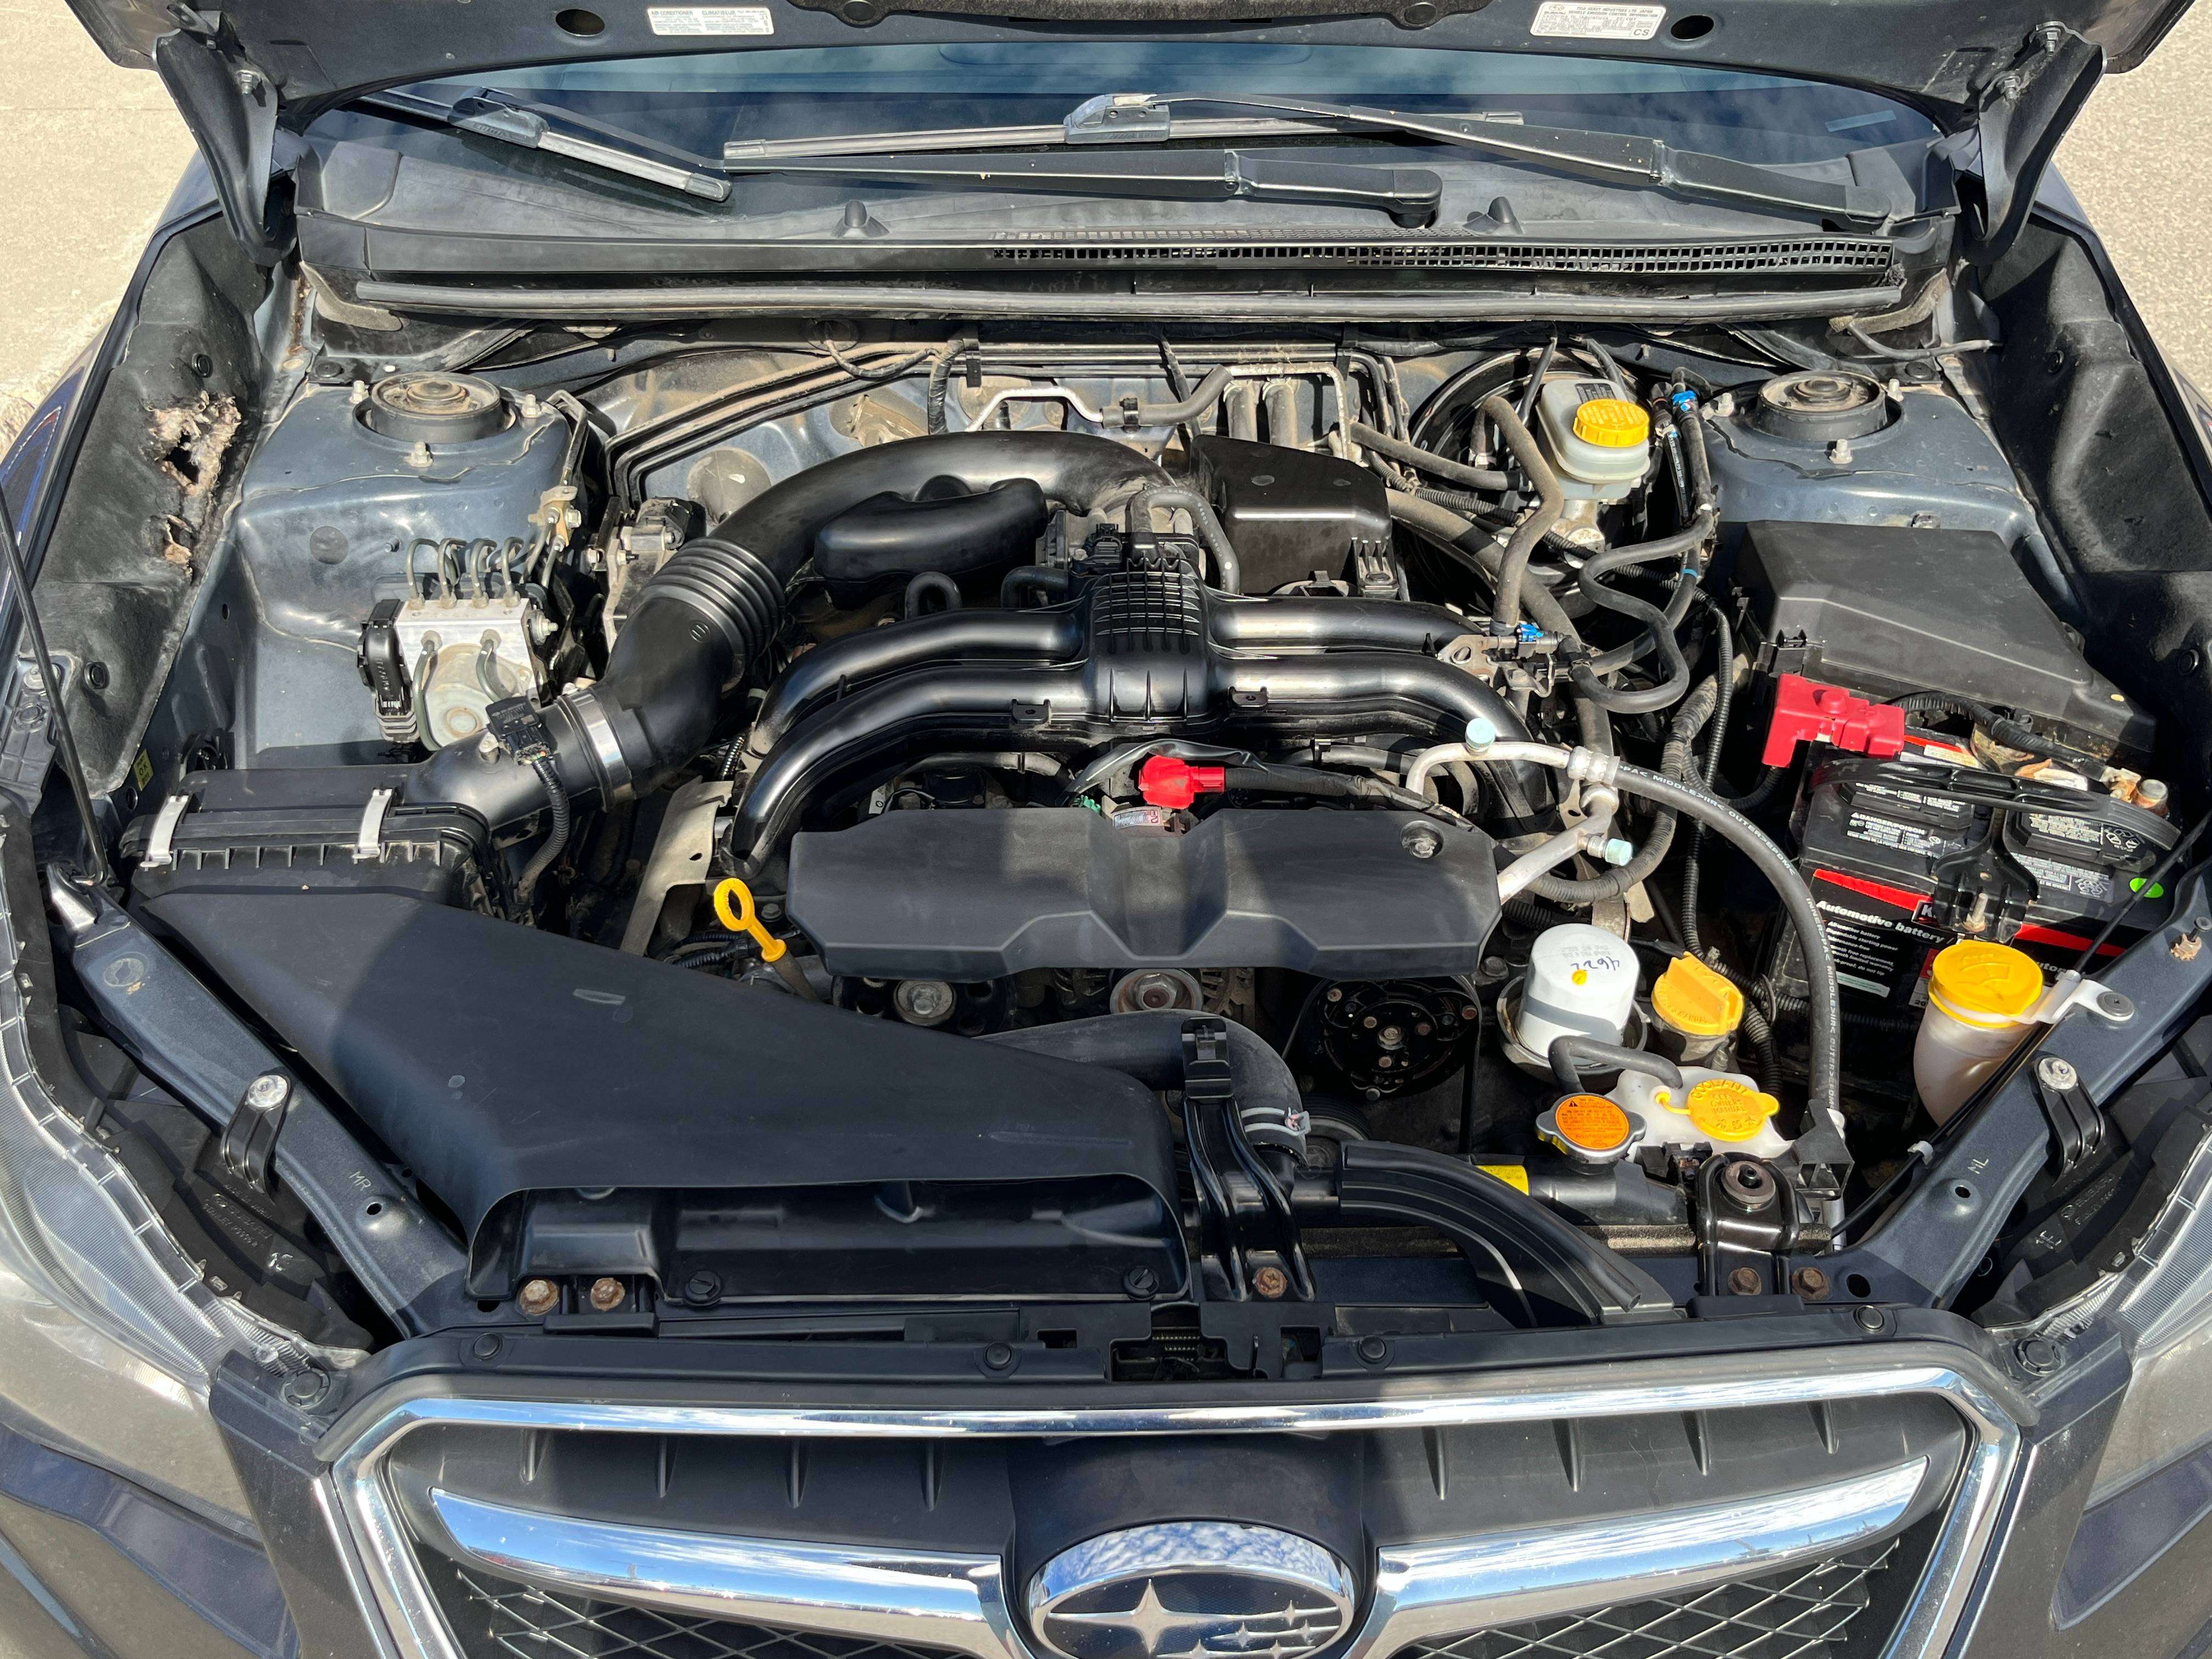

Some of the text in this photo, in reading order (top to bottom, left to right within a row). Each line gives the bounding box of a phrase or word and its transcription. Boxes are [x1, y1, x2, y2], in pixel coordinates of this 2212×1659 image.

[1816, 900, 1893, 928] Automotive
[1894, 922, 1945, 944] battery
[1691, 1079, 1749, 1098] COOLANT
[1713, 1105, 1746, 1114] MANUAL
[348, 1171, 371, 1191] MR
